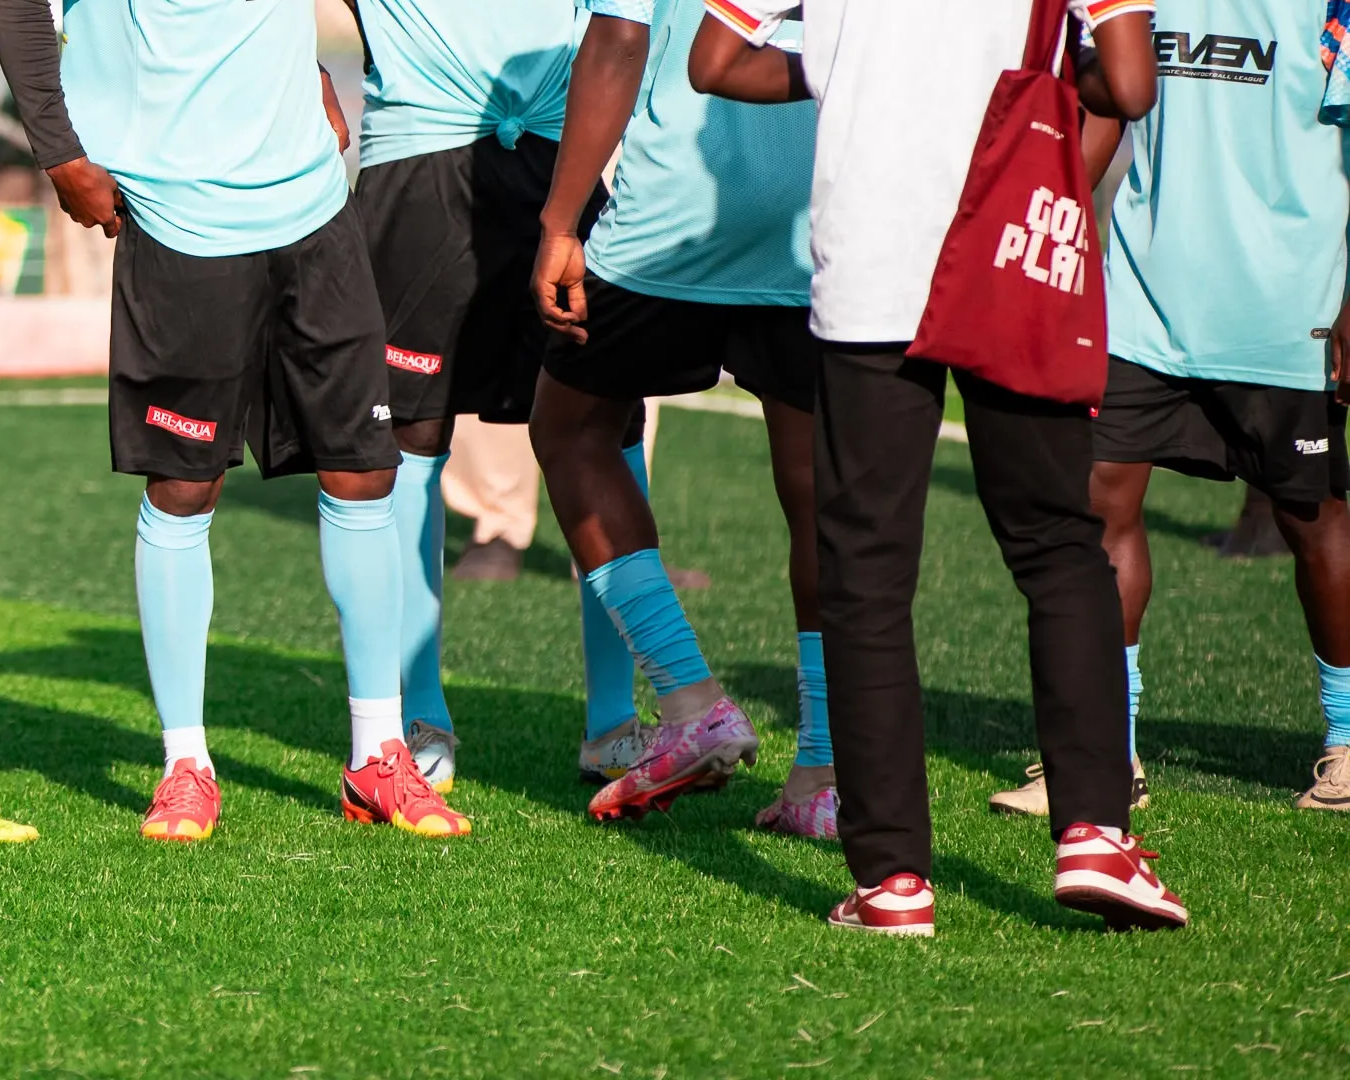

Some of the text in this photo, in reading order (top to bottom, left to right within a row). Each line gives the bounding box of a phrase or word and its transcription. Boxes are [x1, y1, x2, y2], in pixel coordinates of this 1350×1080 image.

[1150, 30, 1278, 71] EVEN
[1233, 75, 1265, 83] LEAGUE
[895, 878, 916, 889] NIKE
